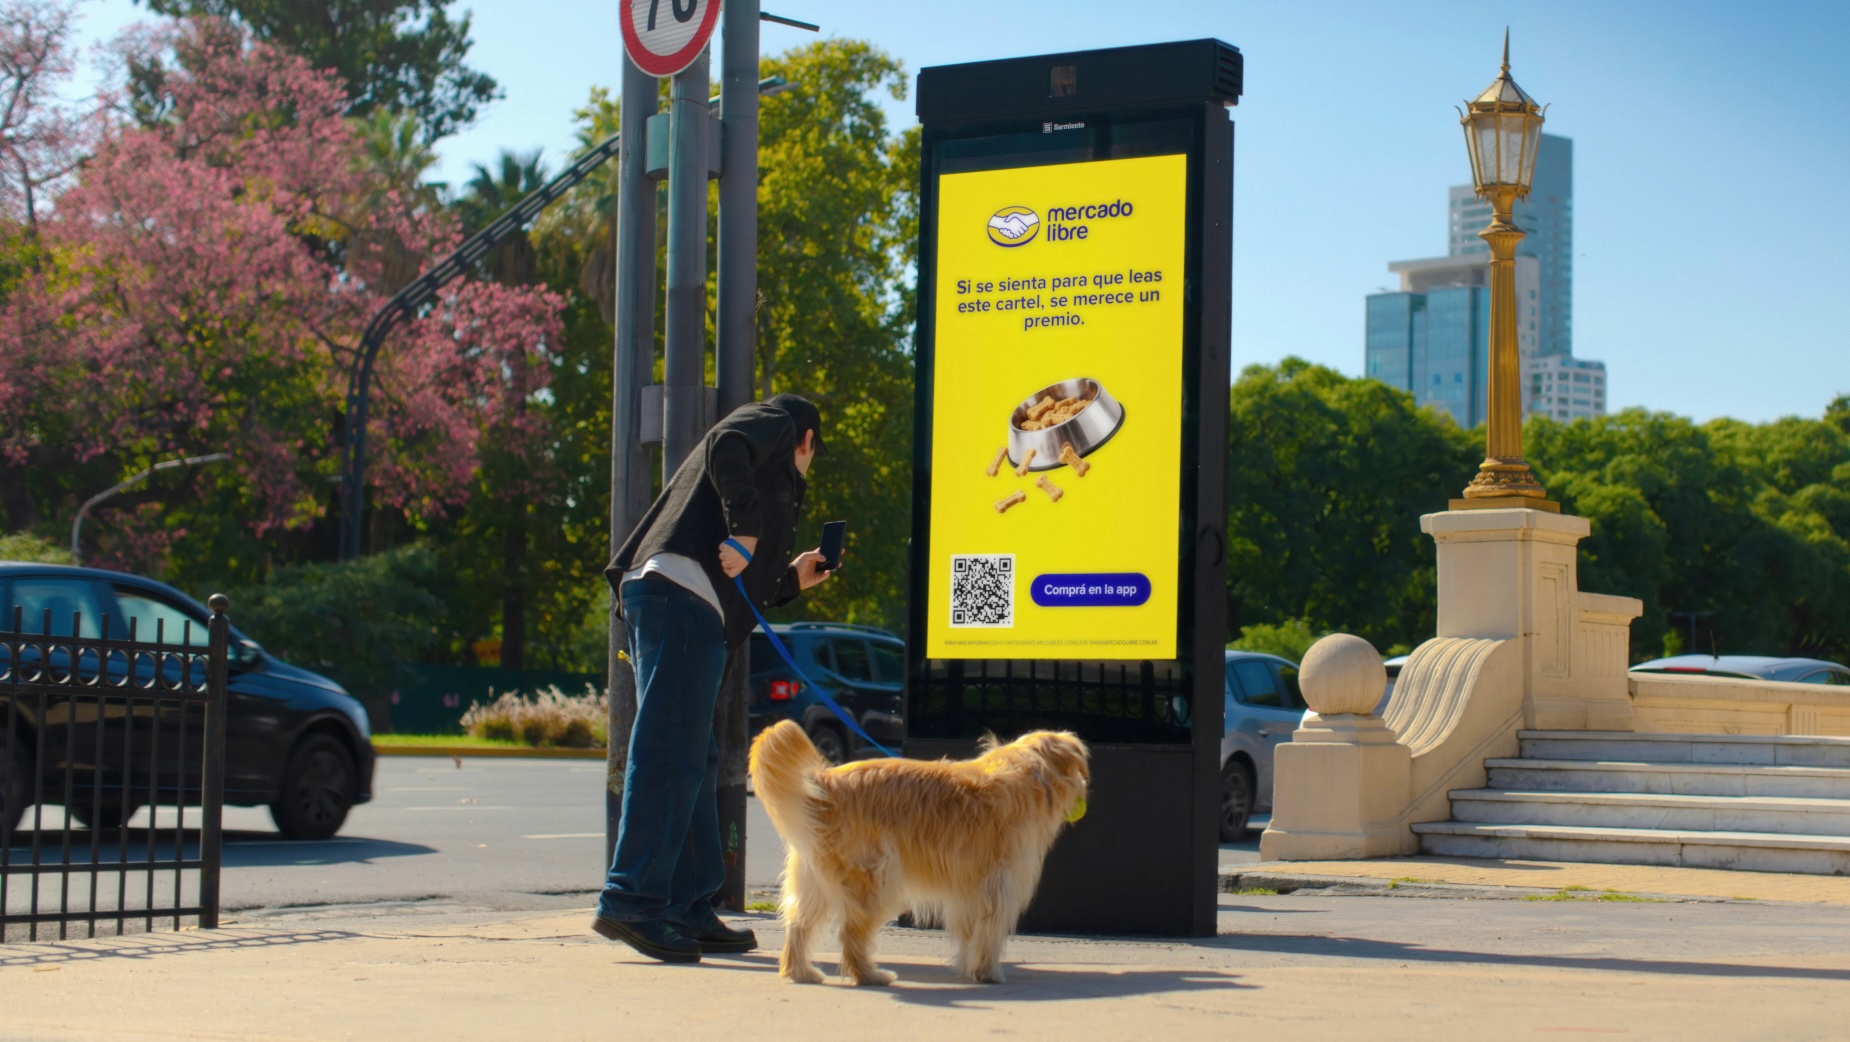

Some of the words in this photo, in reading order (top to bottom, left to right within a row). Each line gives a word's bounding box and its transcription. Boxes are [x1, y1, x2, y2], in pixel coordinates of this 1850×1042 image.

[1053, 122, 1085, 130] Sarmiento
[1047, 199, 1133, 221] mercado
[1047, 224, 1088, 241] libre
[957, 280, 970, 294] Si
[977, 282, 993, 293] se
[999, 277, 1046, 291] sienta
[1052, 276, 1087, 291] para
[1093, 274, 1123, 289] que
[1130, 269, 1162, 283] leas
[958, 300, 990, 313] este
[996, 295, 1044, 310] cartel,
[1051, 297, 1067, 307] se
[1074, 292, 1134, 305] merece
[1140, 291, 1159, 302] un
[1025, 312, 1084, 331] premio.
[1044, 584, 1086, 597] Comprá
[1088, 586, 1102, 595] en
[1104, 584, 1114, 595] la
[1116, 585, 1137, 597] app
